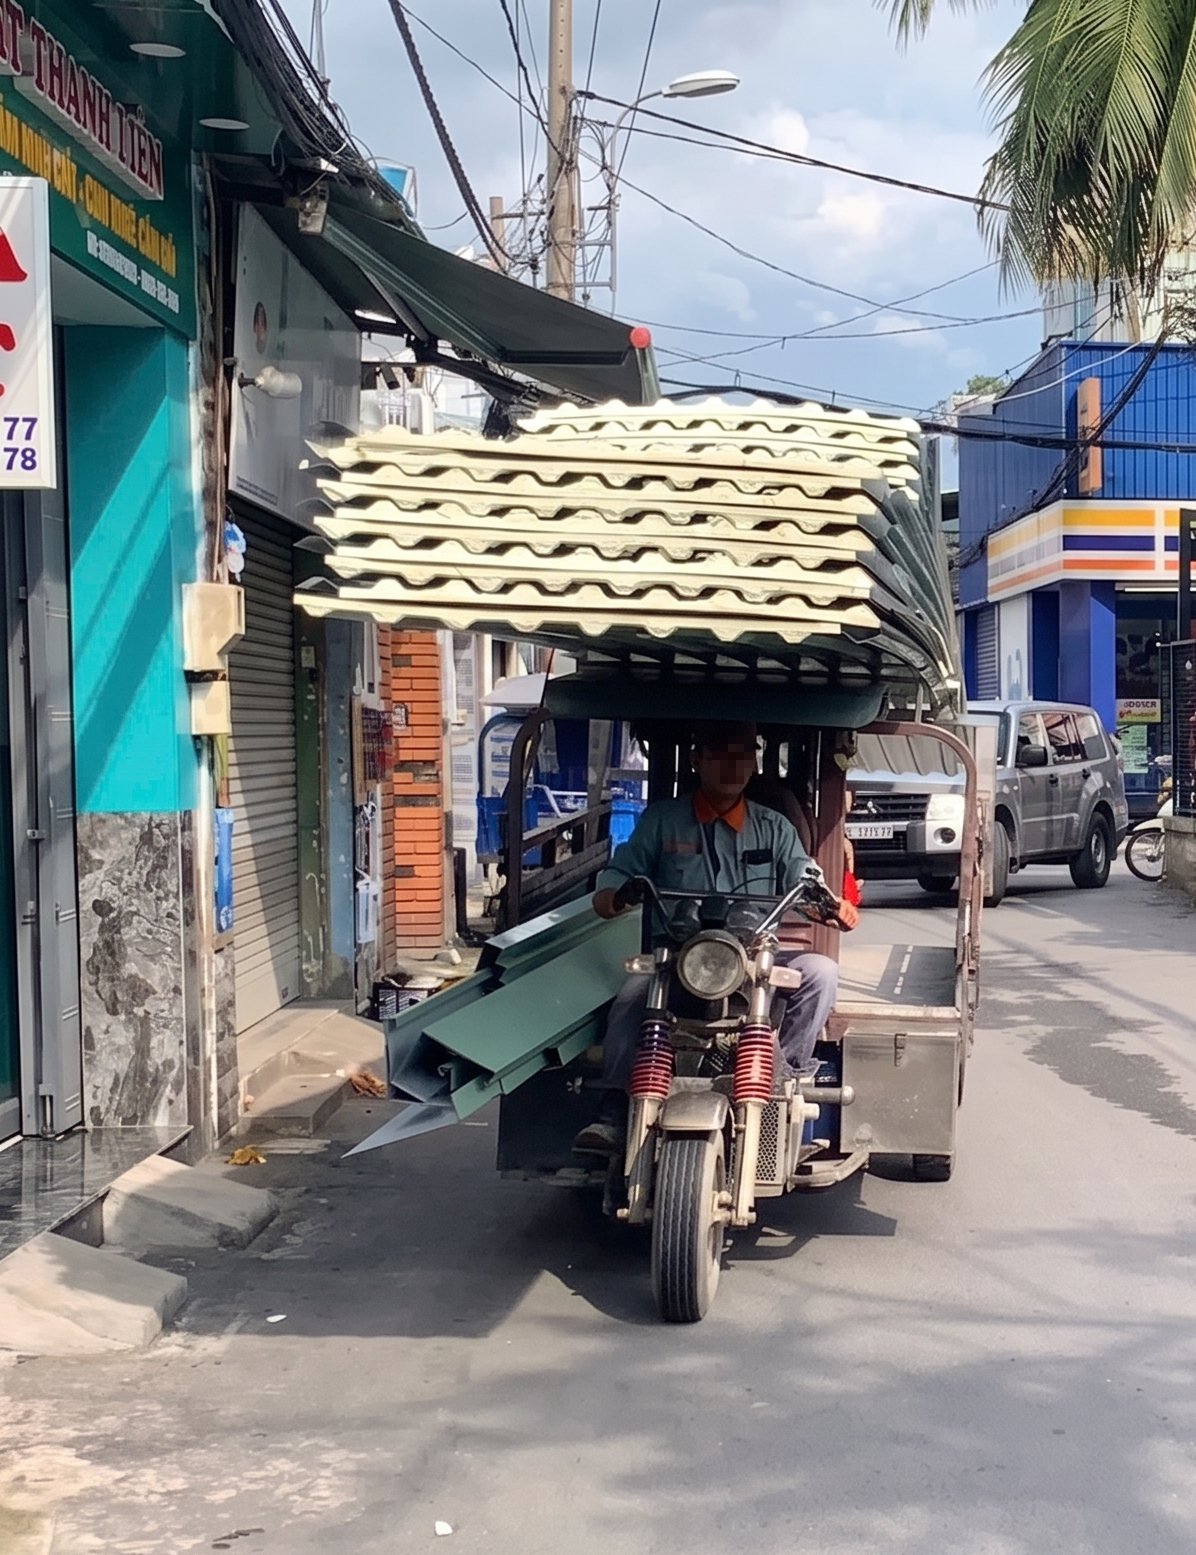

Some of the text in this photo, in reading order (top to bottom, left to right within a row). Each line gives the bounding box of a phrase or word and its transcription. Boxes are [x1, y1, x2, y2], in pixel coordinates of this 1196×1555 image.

[31, 16, 112, 154] THANH
[3, 417, 38, 441] 77
[3, 447, 37, 471] 78
